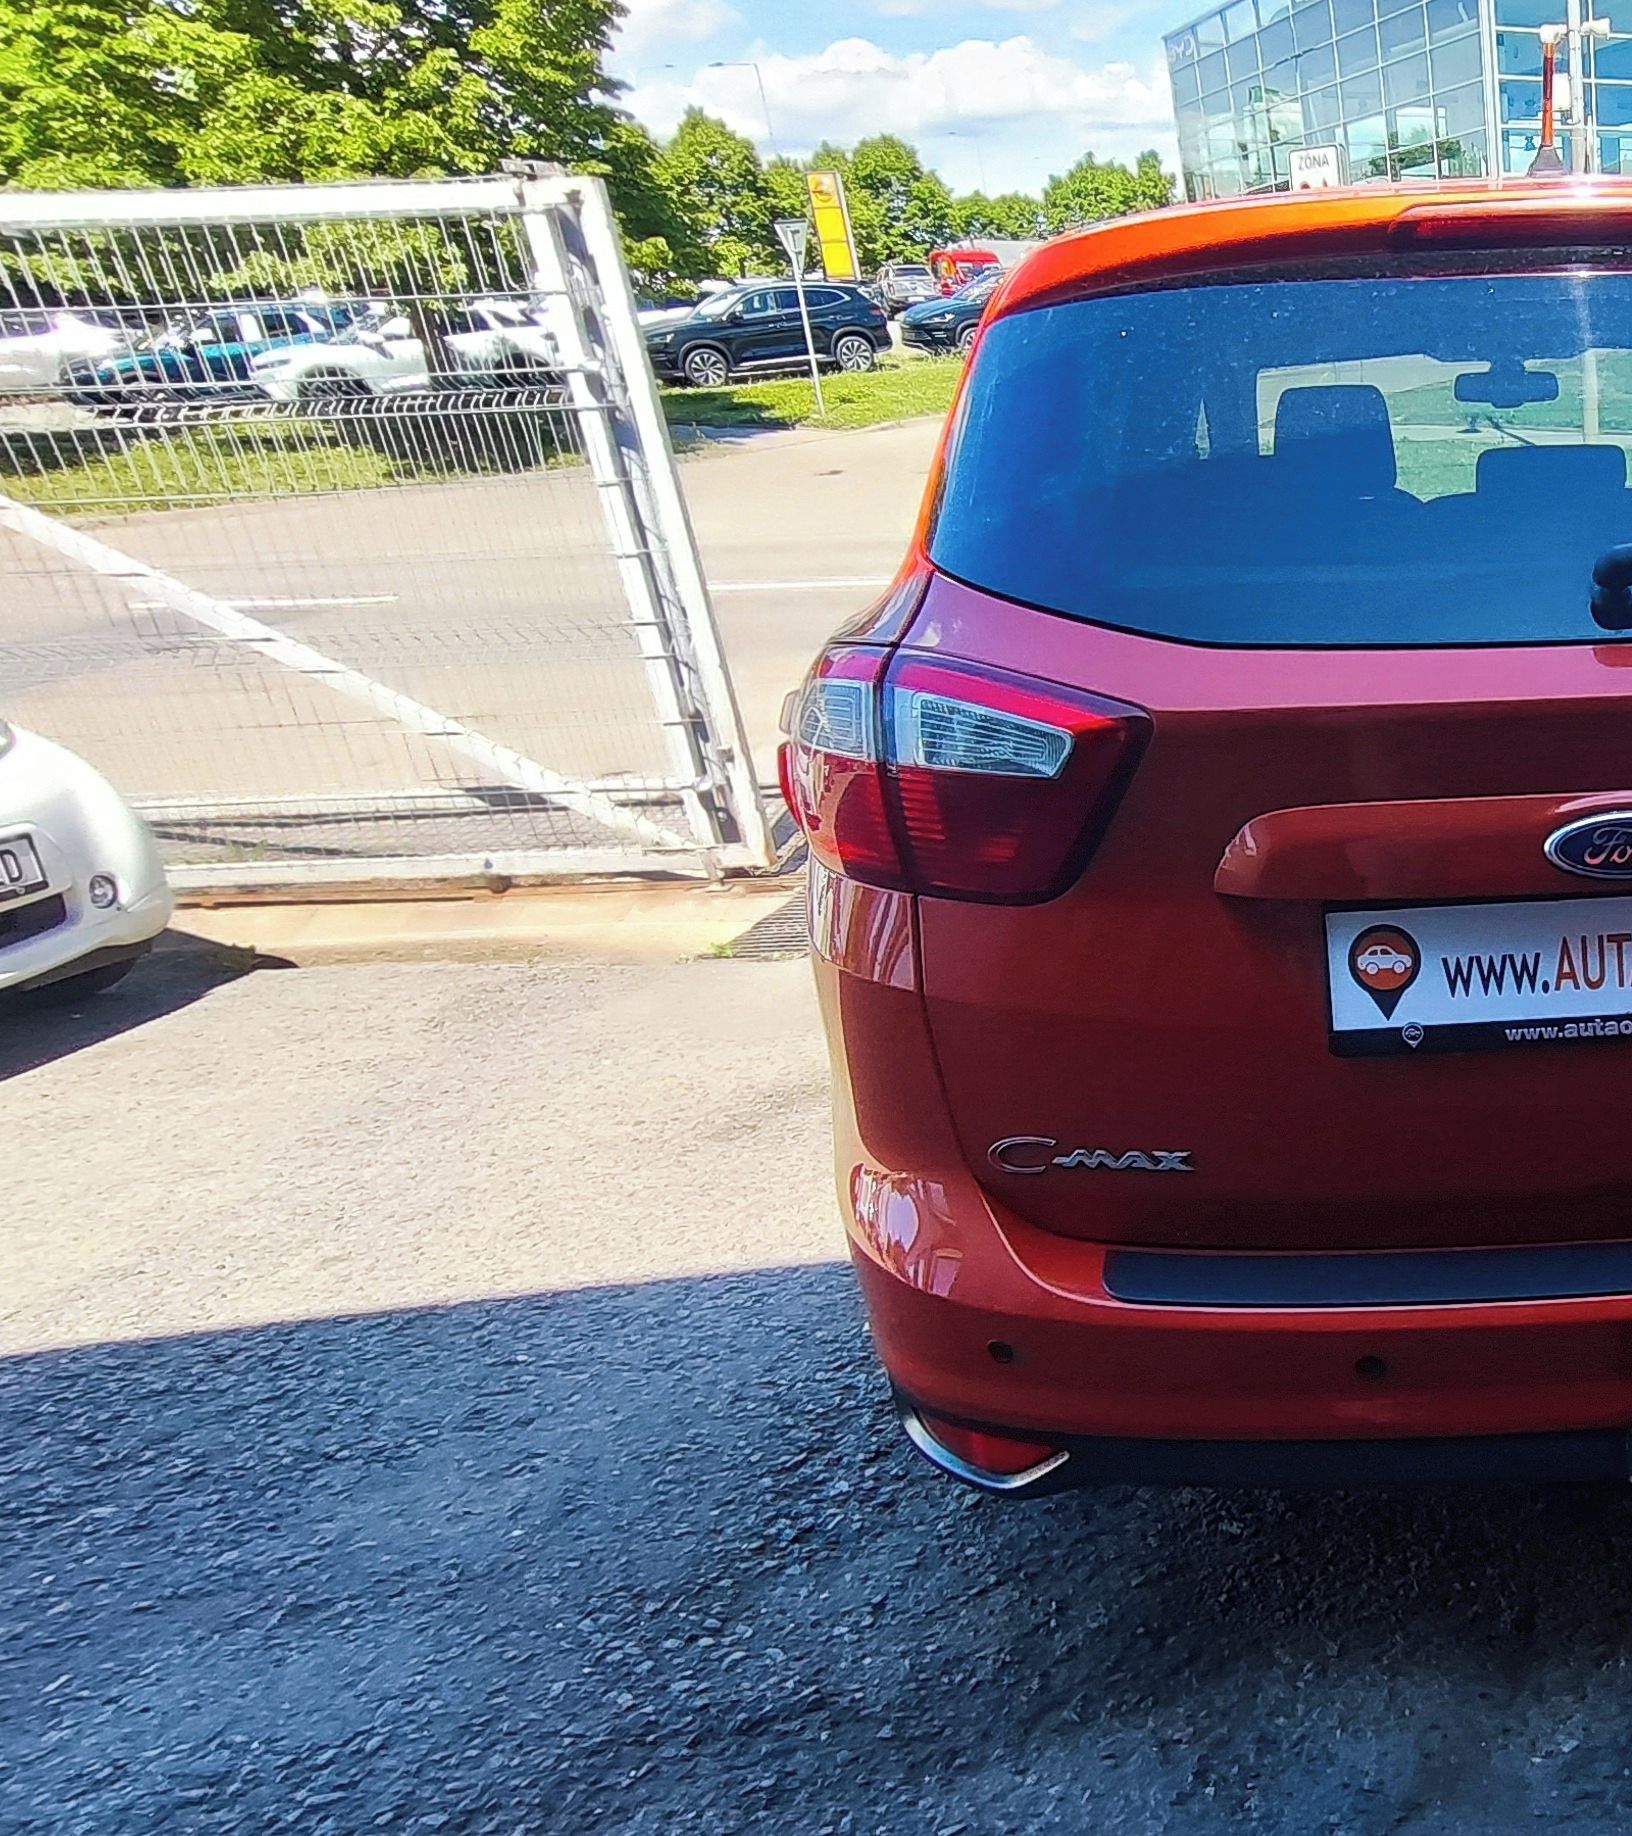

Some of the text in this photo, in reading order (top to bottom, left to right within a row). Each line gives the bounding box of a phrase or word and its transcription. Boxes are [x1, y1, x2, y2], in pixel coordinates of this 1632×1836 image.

[1298, 152, 1330, 171] ZÓNA
[0, 848, 23, 886] D
[987, 1136, 1196, 1173] C-MAX
